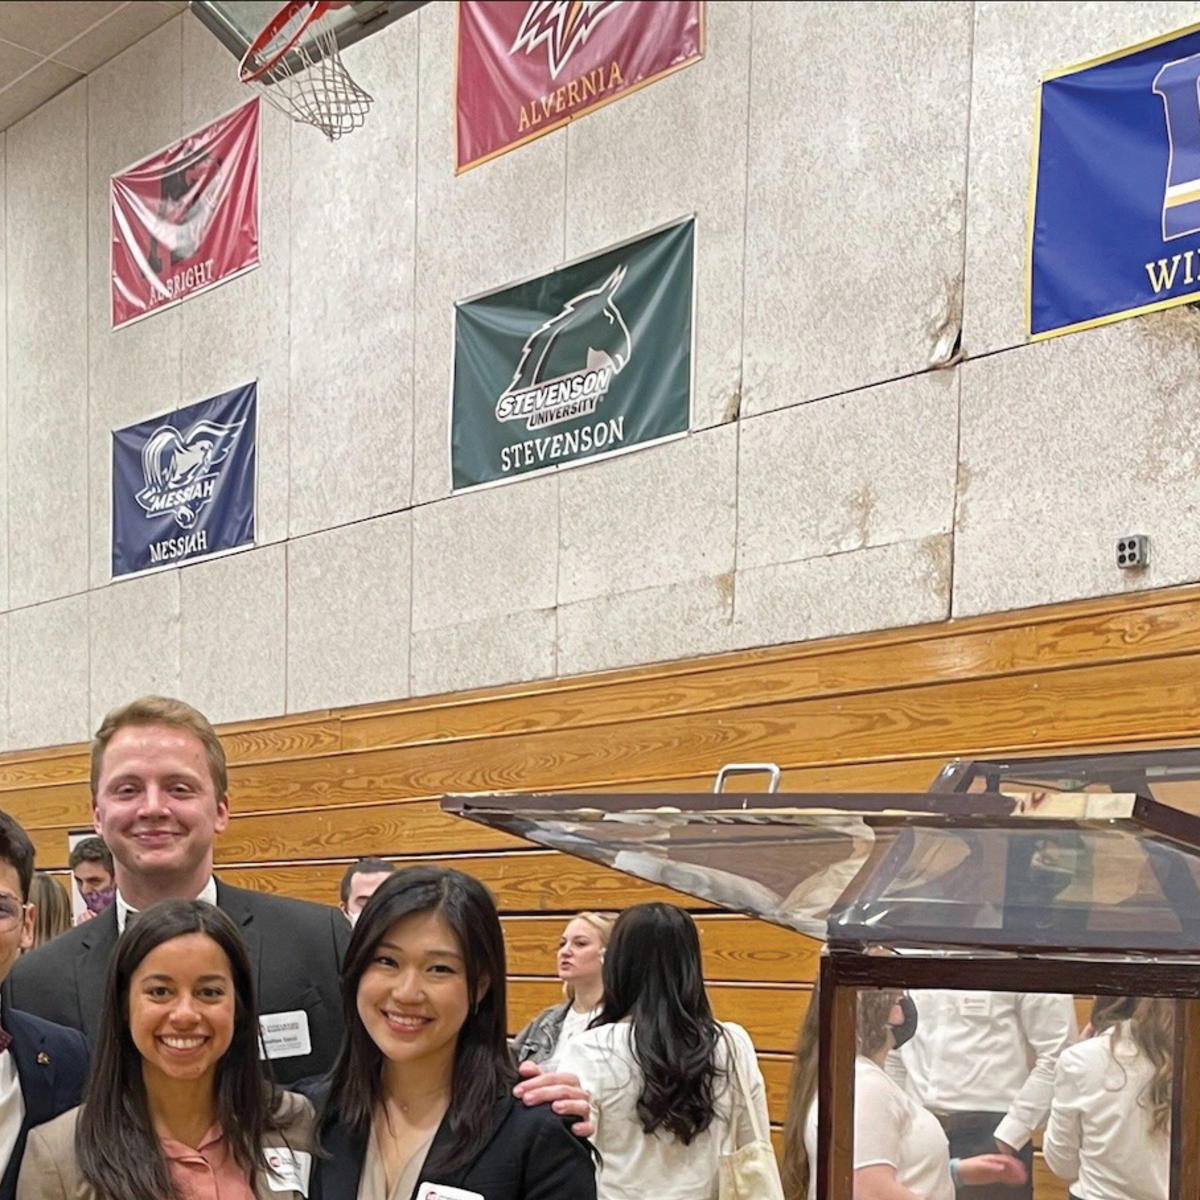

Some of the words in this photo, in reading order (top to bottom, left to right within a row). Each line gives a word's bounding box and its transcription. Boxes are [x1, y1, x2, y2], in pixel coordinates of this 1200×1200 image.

[518, 61, 623, 132] ALVERNIA
[1145, 247, 1200, 294] WI
[497, 367, 611, 418] STEVENSON
[530, 398, 597, 427] UNIVERSITY
[501, 416, 625, 472] STEVENSON
[151, 480, 215, 511] MESSIAH
[149, 530, 208, 562] MESSIAH
